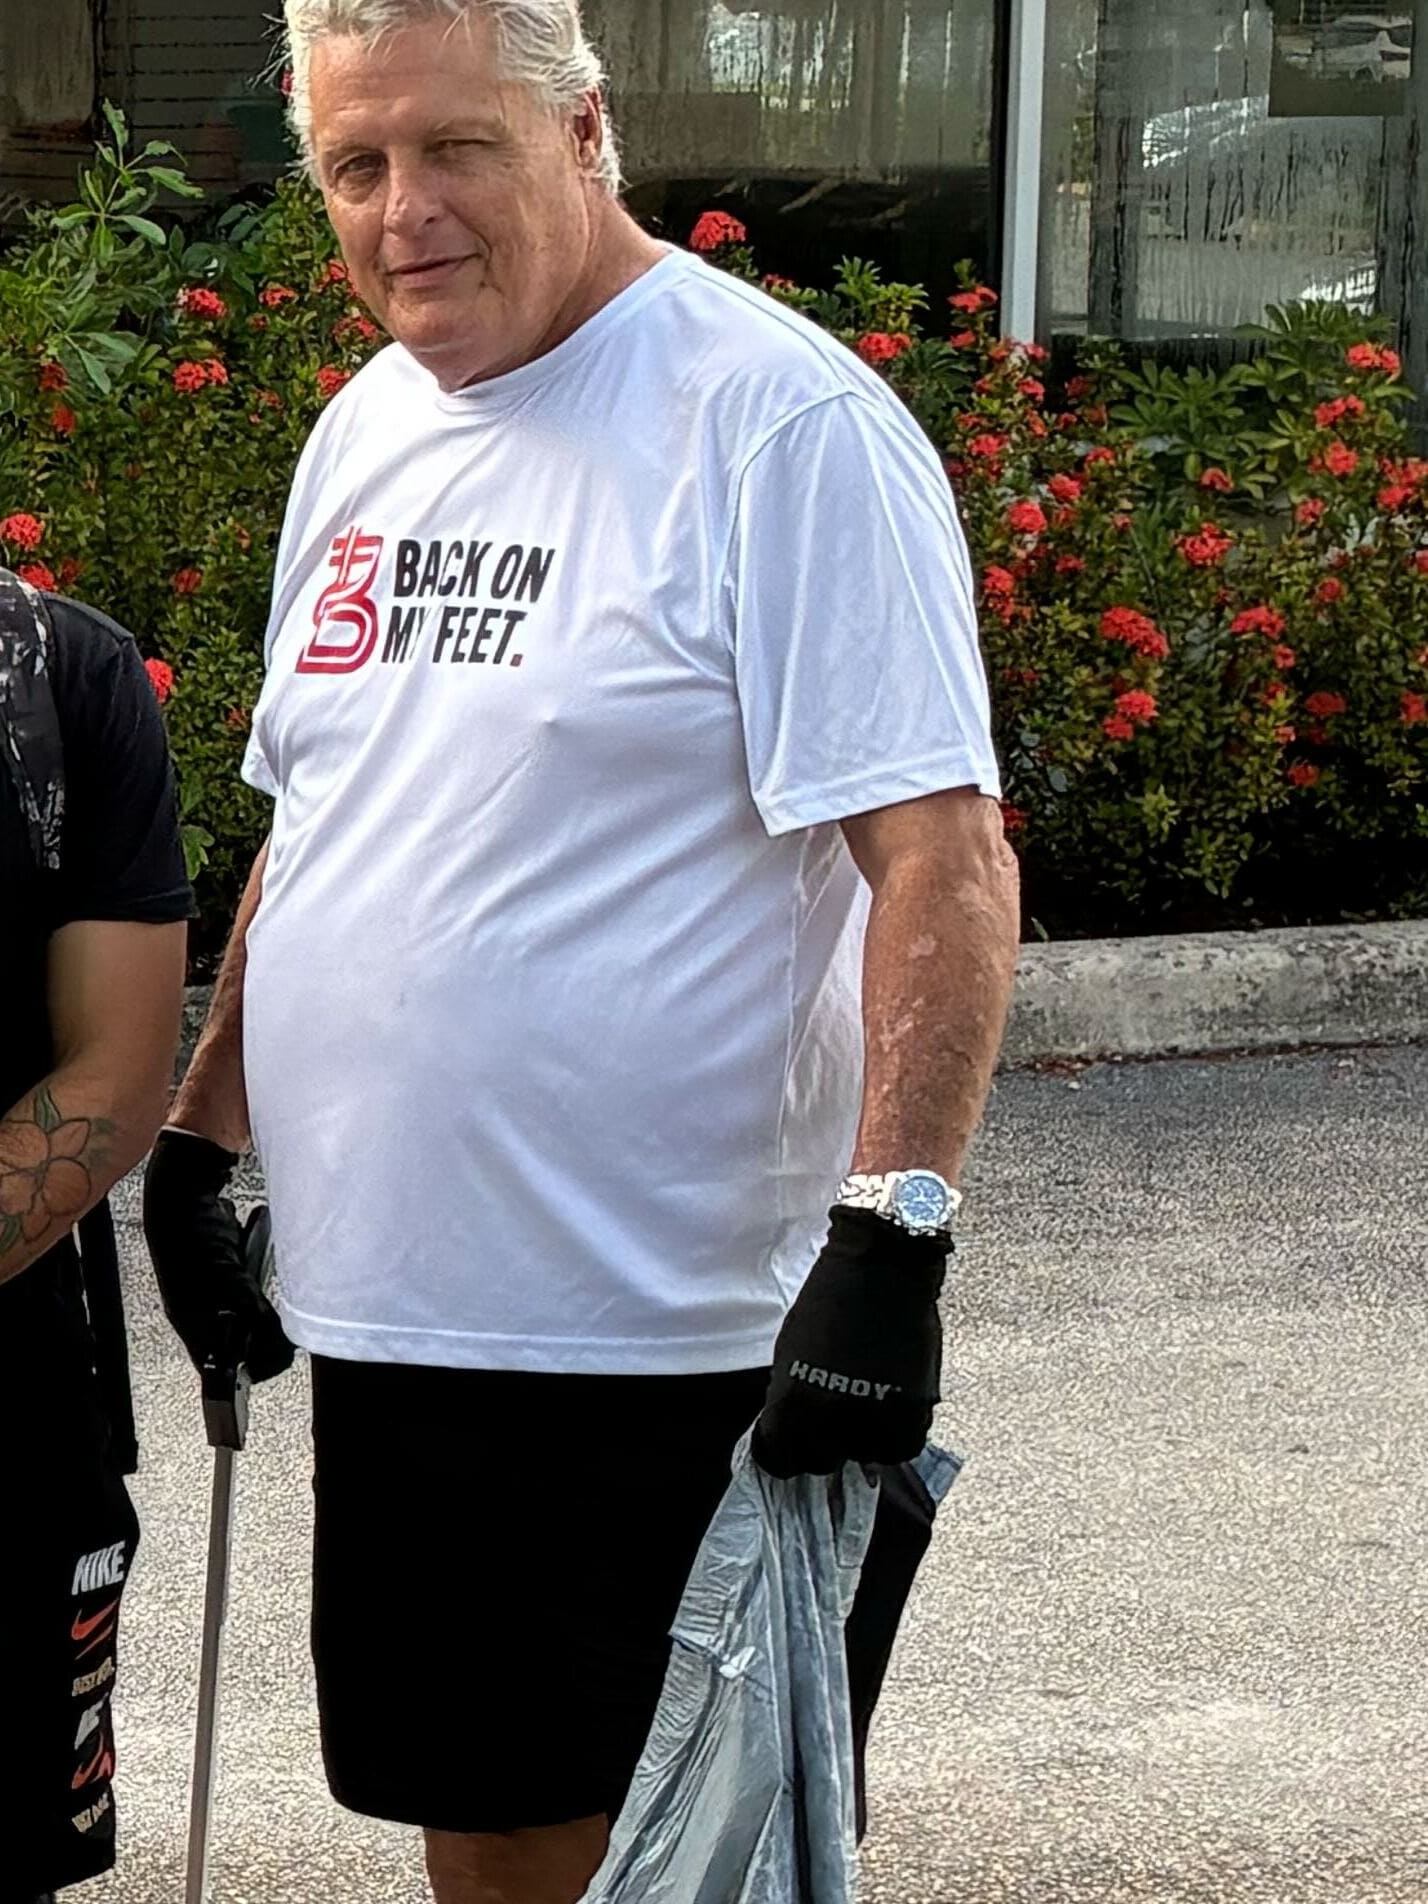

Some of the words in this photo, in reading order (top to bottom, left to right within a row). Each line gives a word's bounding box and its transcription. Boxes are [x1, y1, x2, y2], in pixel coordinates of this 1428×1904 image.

[393, 539, 494, 599] BACK
[490, 544, 556, 604] ON
[380, 604, 432, 663] MY
[431, 605, 528, 668] FEET.
[789, 1359, 892, 1401] HARDY
[71, 1540, 126, 1596] NIKE
